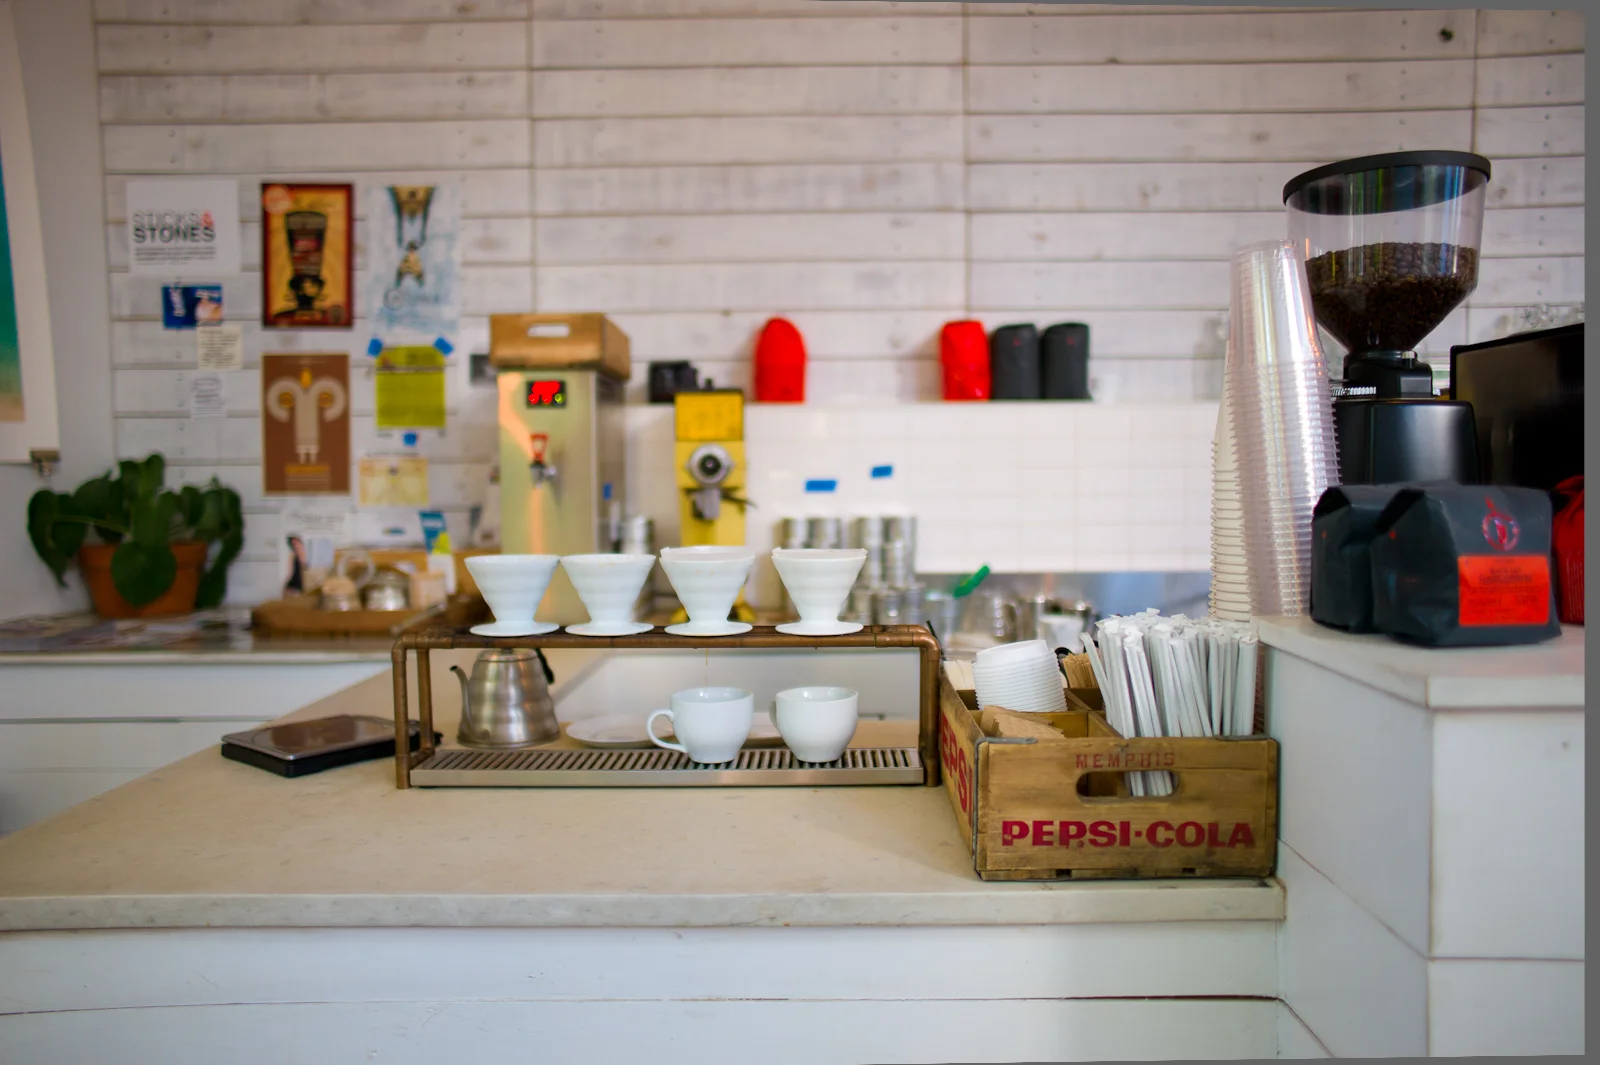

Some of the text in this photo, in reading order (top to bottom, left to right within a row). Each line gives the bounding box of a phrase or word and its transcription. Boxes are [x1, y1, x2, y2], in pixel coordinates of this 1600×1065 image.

[133, 225, 215, 243] STONES
[941, 709, 973, 828] EPSI
[1076, 752, 1176, 769] MEMPHIS
